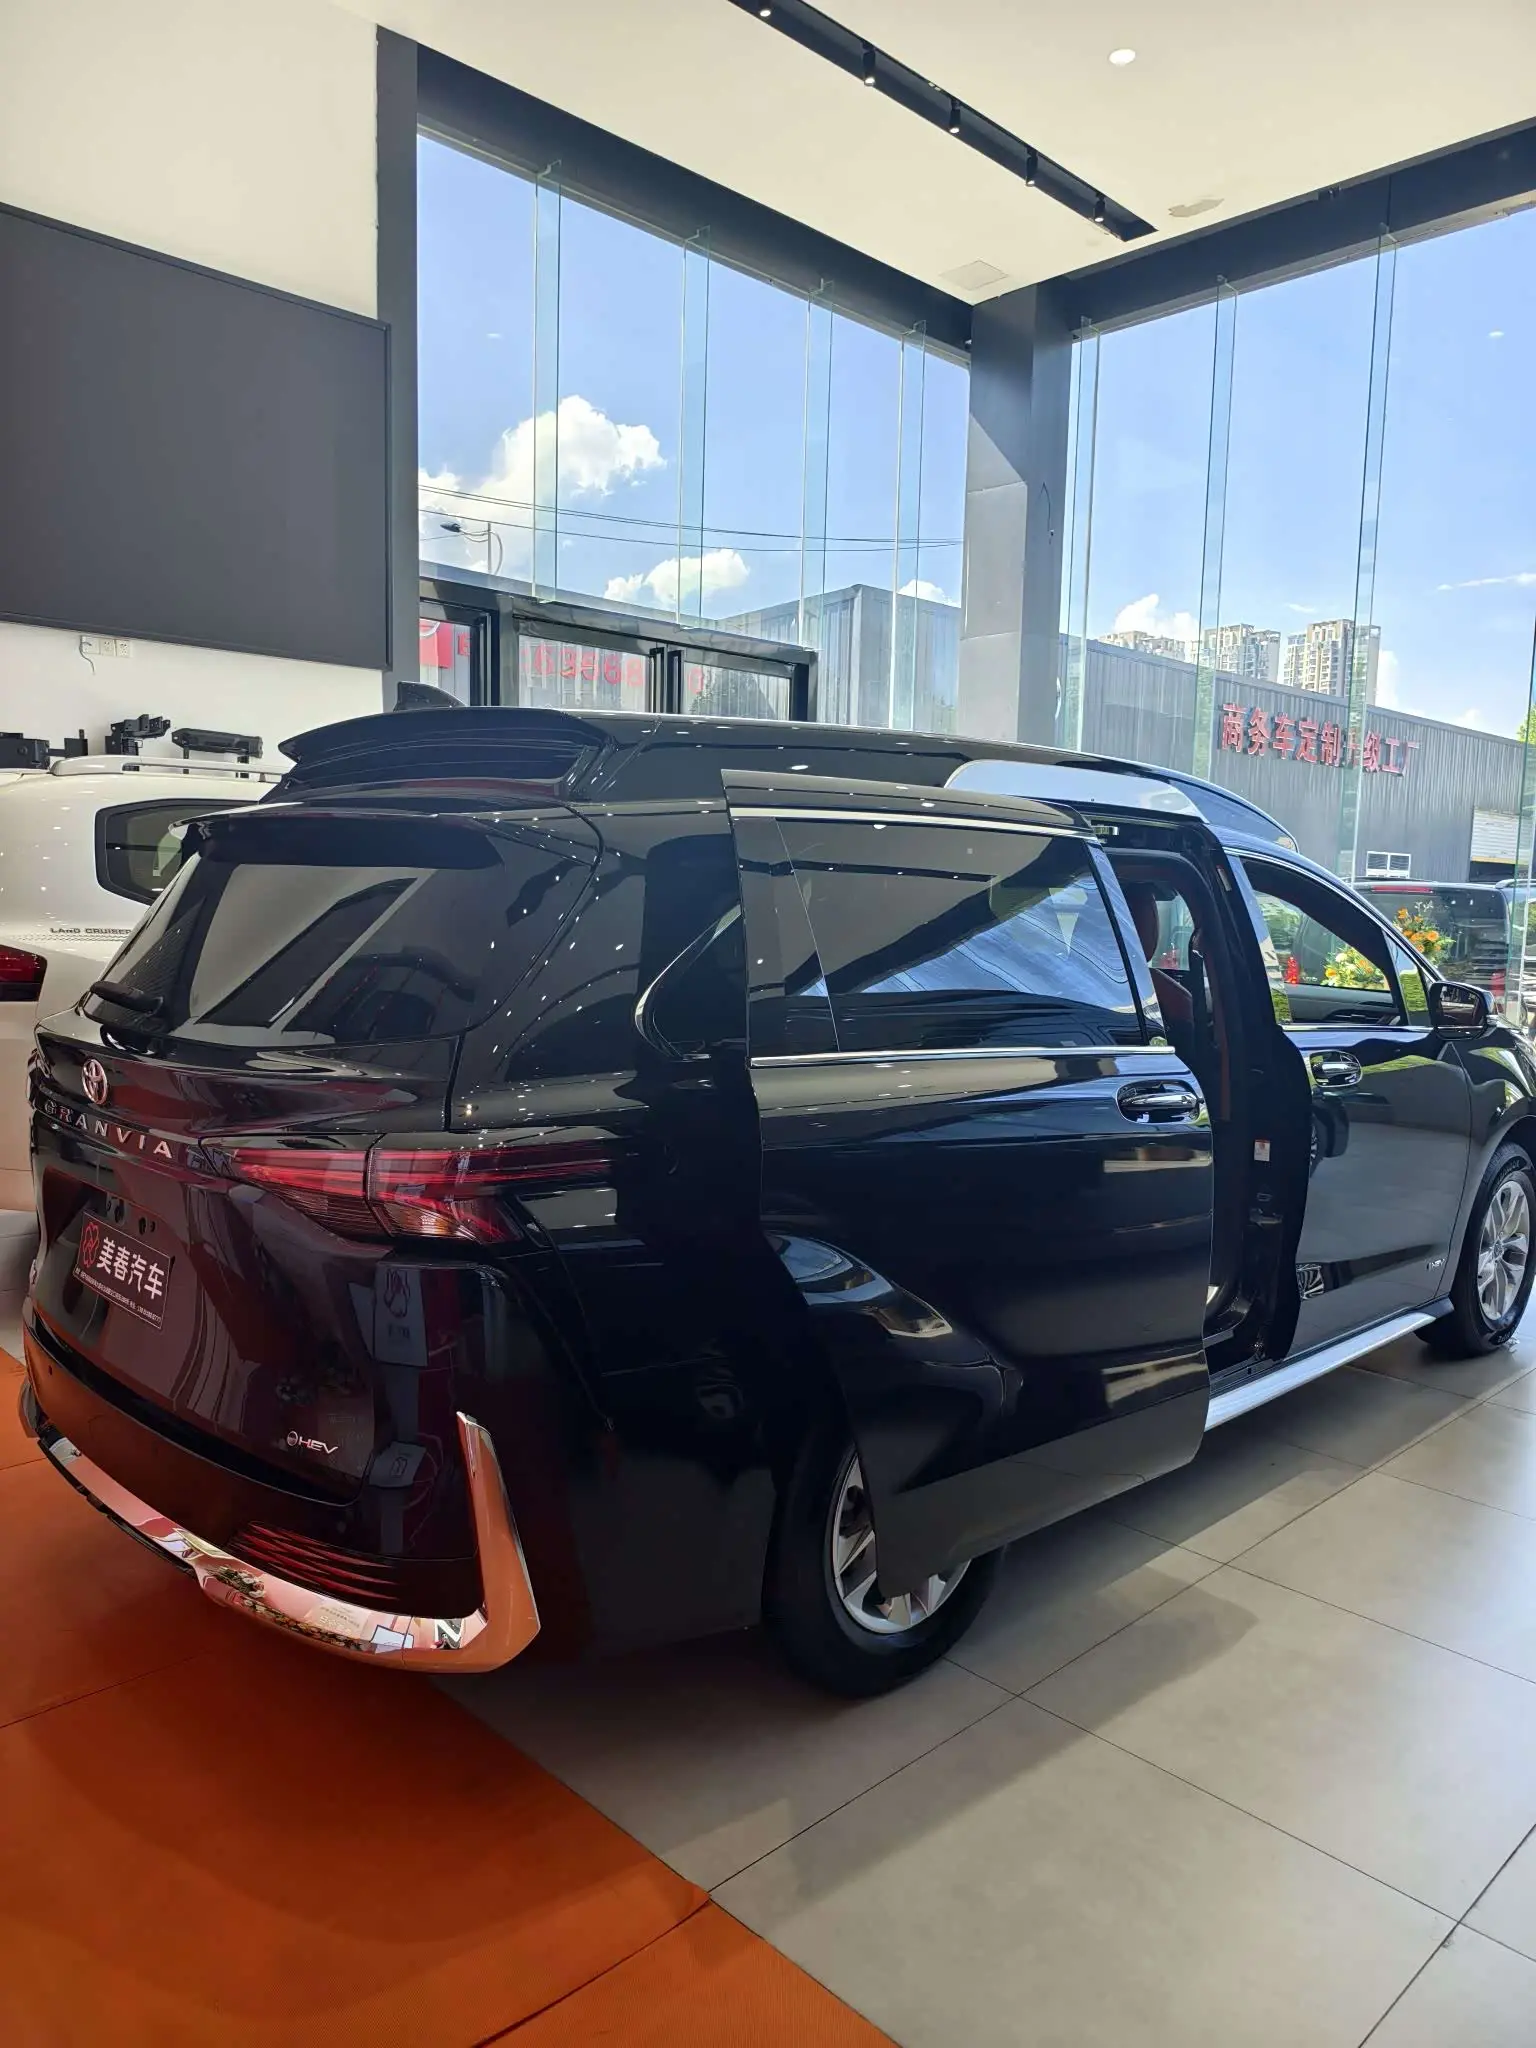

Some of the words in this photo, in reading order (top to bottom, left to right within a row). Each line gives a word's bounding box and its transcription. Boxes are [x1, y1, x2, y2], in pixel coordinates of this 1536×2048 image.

[44, 1101, 173, 1159] GRANVIA
[97, 1236, 165, 1300] 美春汽车
[298, 1433, 339, 1454] HEV
